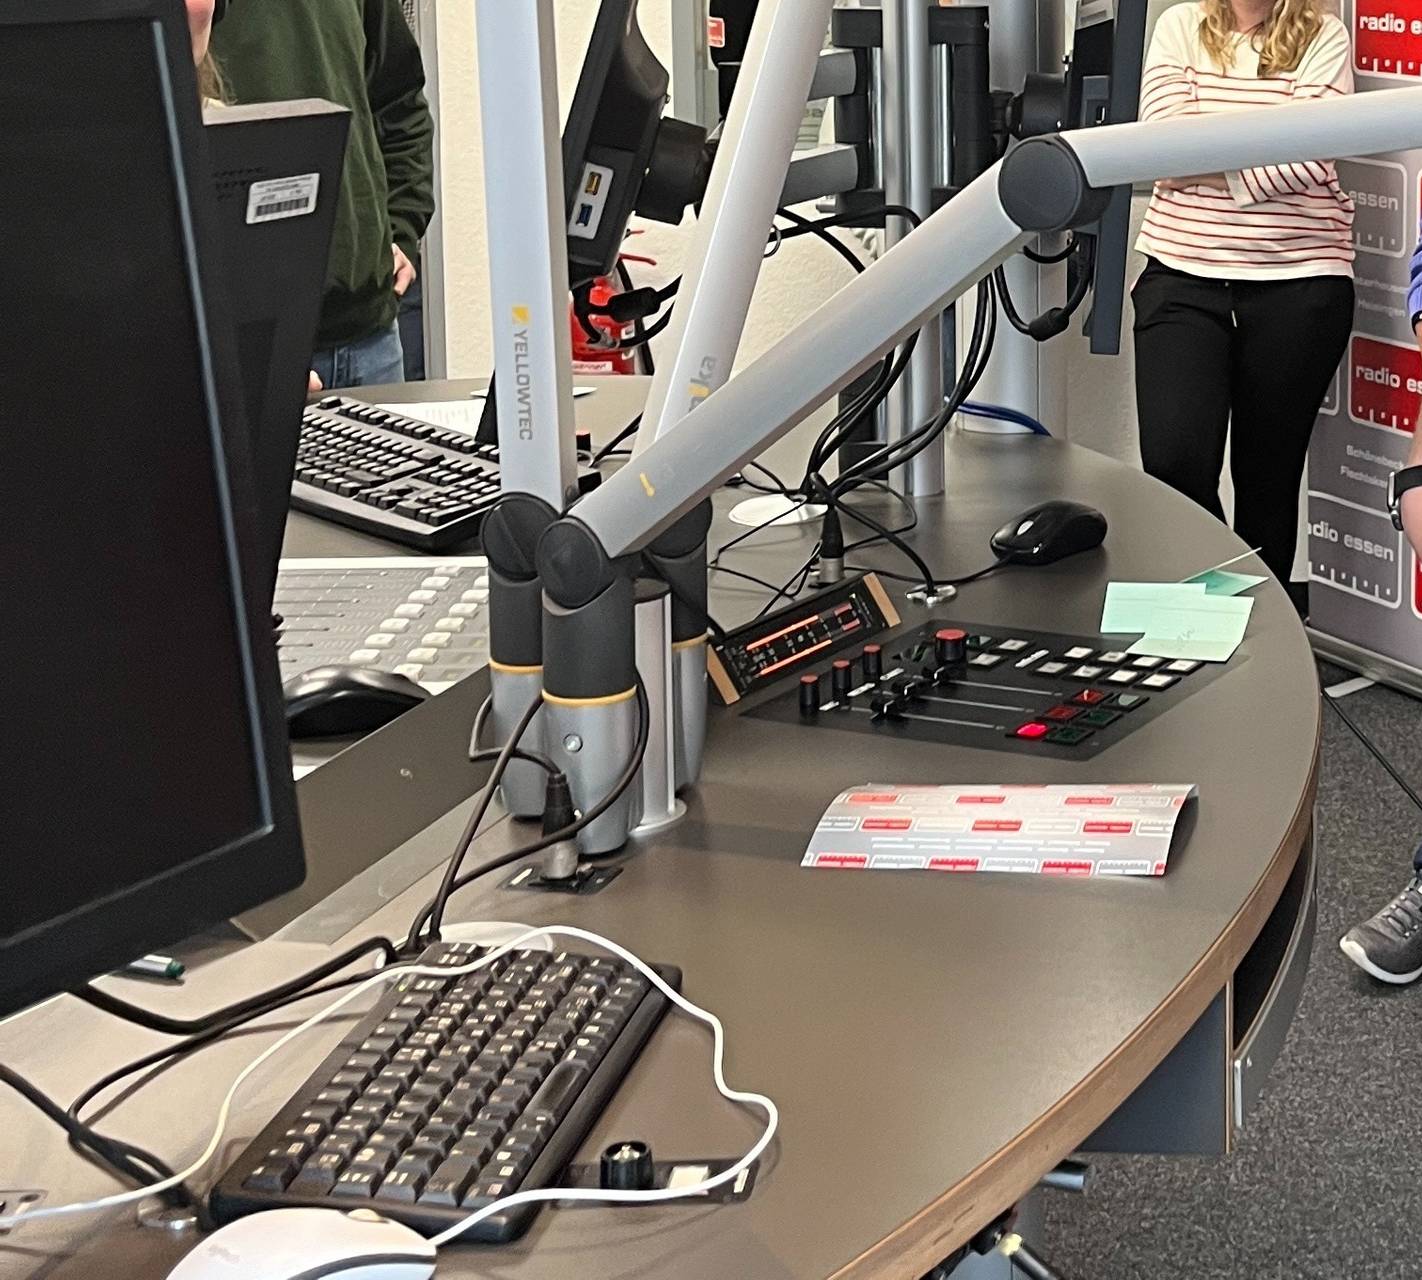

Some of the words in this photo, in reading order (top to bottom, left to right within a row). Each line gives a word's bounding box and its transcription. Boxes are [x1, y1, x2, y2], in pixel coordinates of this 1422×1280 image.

[1359, 13, 1406, 33] radio
[1348, 190, 1398, 211] essen
[513, 329, 533, 441] YELLOWTEC
[1355, 365, 1401, 388] radio
[1308, 520, 1338, 542] dio
[1343, 534, 1394, 562] essen
